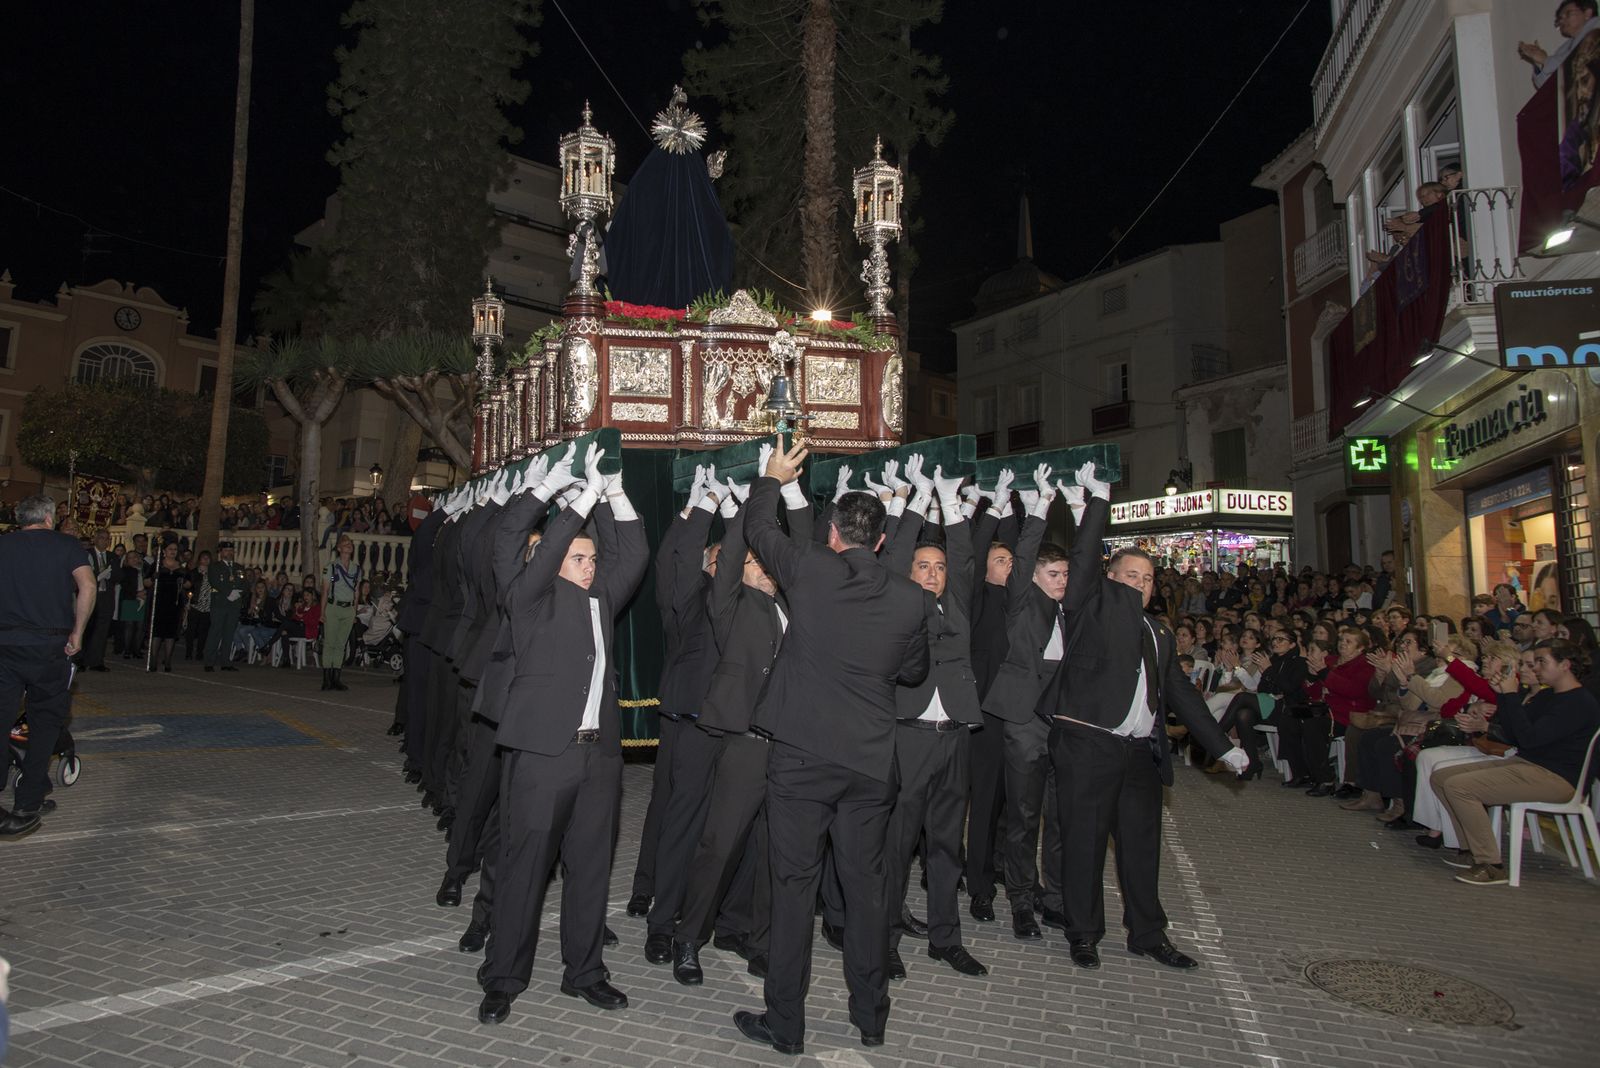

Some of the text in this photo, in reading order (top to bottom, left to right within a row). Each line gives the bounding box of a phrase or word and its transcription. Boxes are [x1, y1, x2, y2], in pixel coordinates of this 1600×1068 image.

[1445, 384, 1547, 460] Farmacia
[1116, 495, 1203, 520] LA FLOR DE JIJONA
[1227, 493, 1287, 511] DULCES
